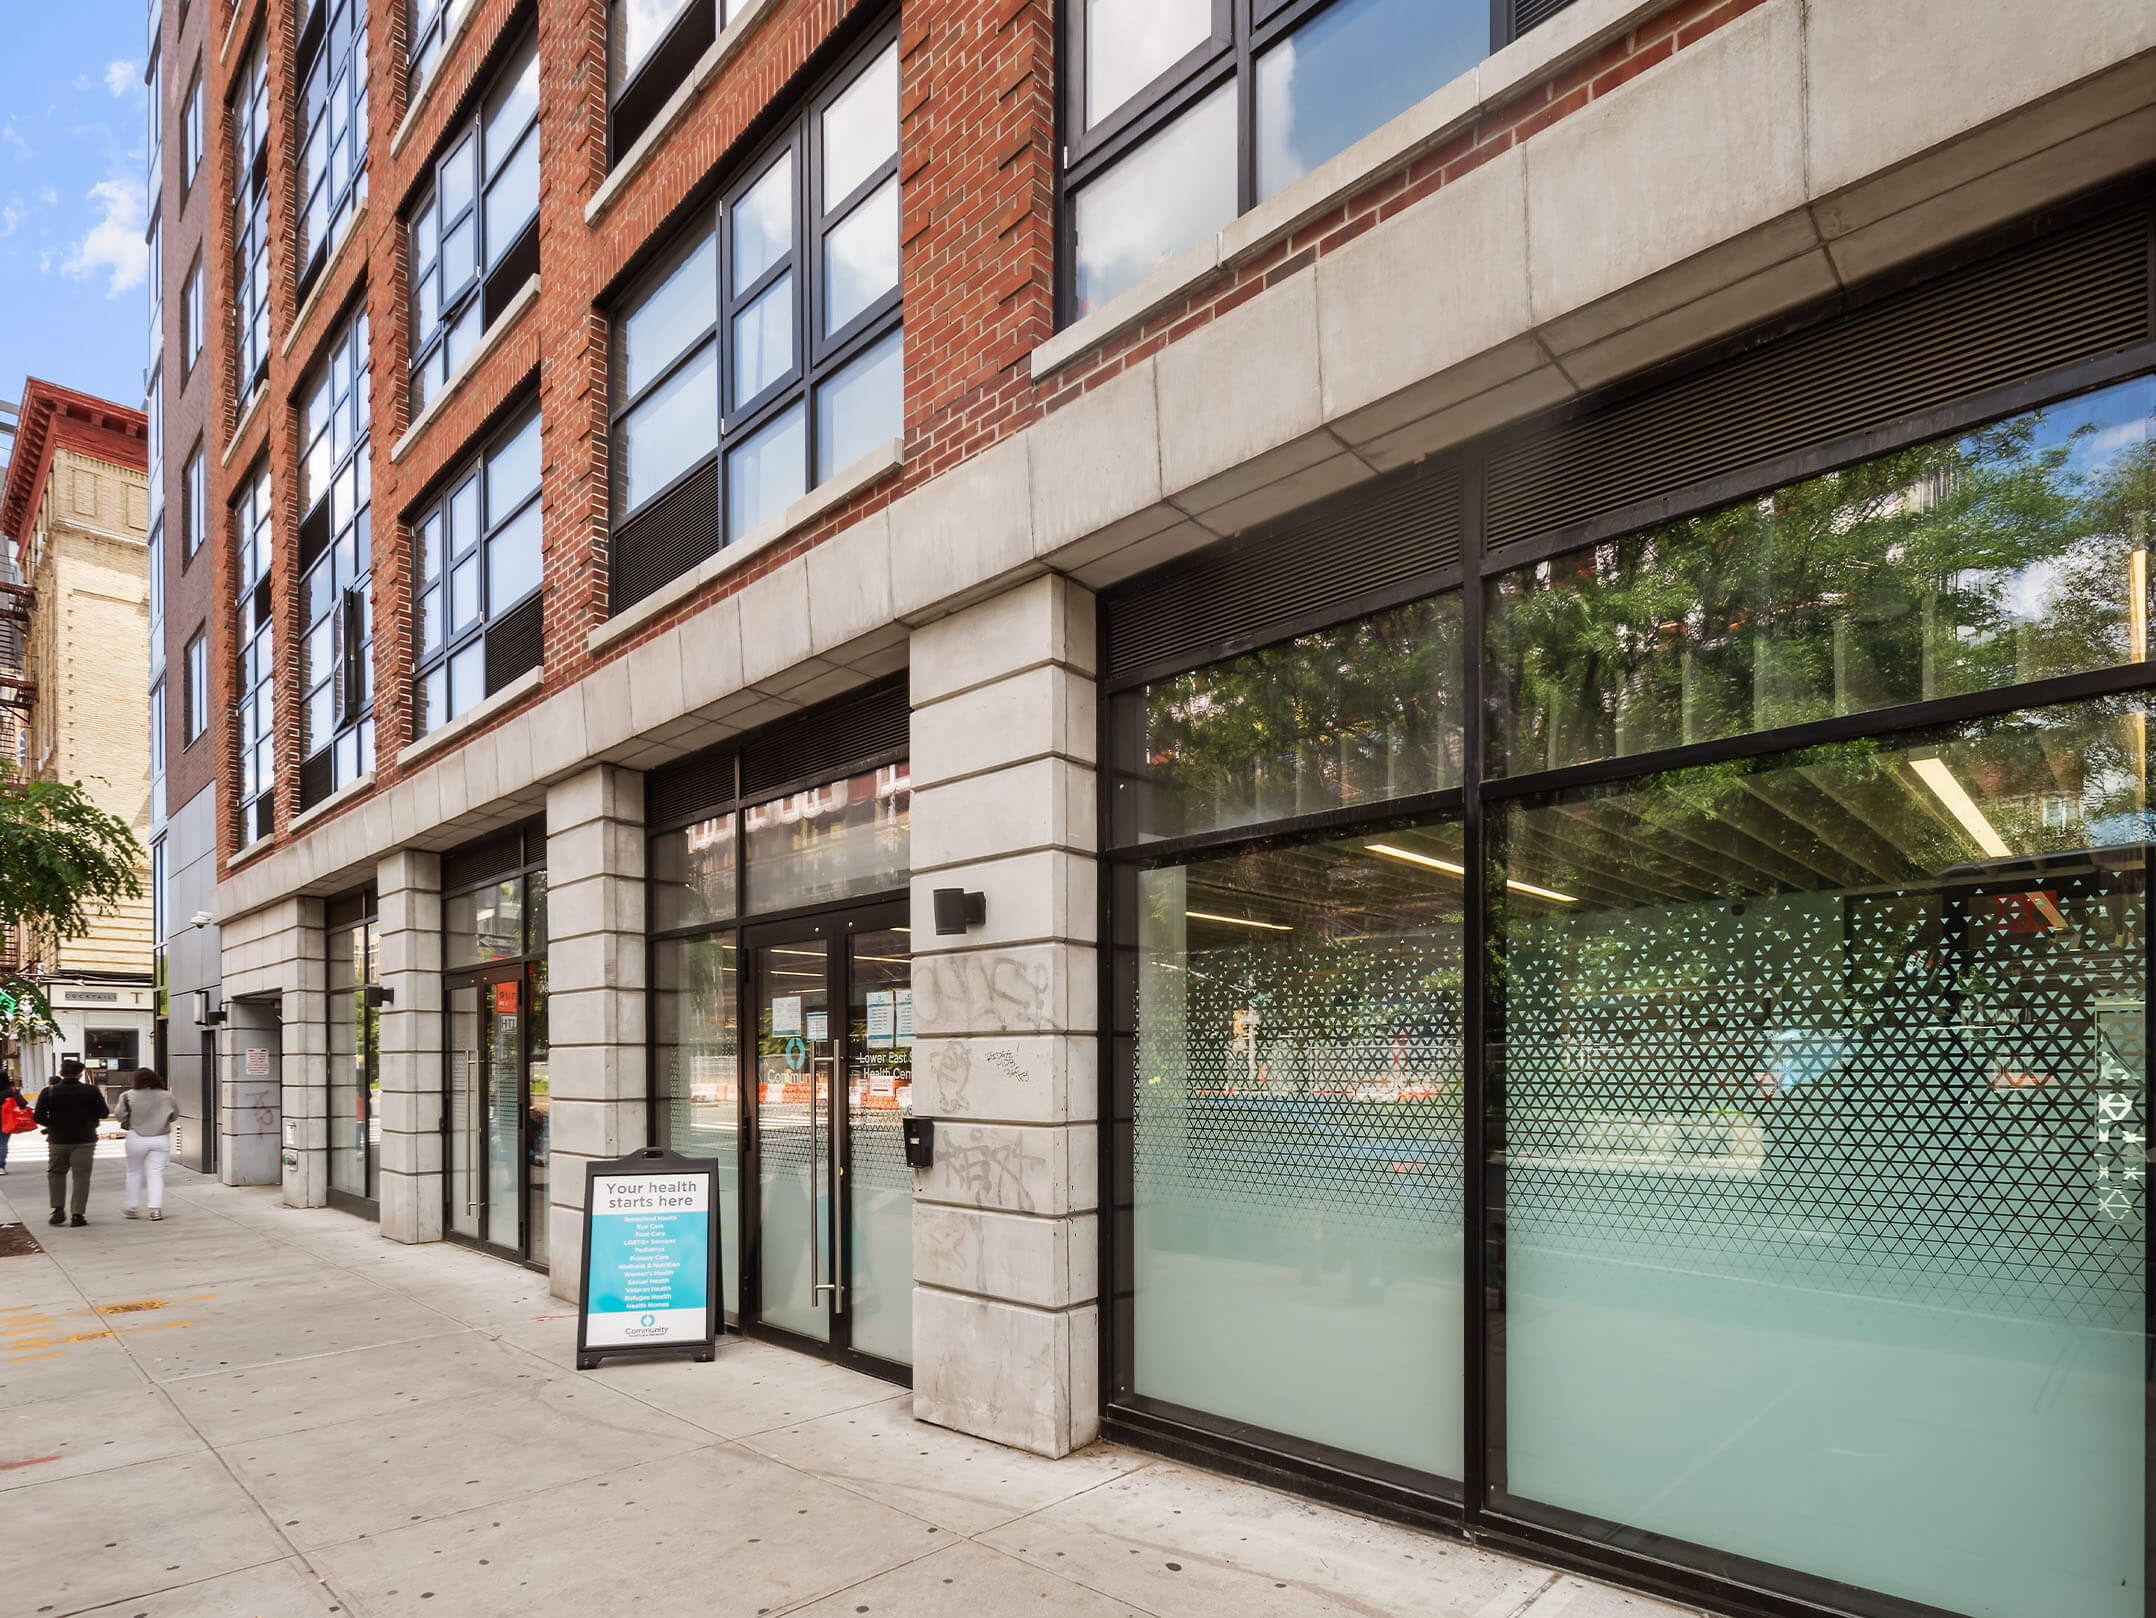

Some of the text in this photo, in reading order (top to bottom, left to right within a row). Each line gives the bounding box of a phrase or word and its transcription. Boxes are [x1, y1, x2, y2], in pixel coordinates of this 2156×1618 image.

[859, 1052, 886, 1064] Lower
[888, 1052, 907, 1064] East
[863, 1067, 912, 1080] Health Cen
[606, 1181, 697, 1194] Your health
[609, 1195, 693, 1208] starts here
[624, 1327, 669, 1335] Community
